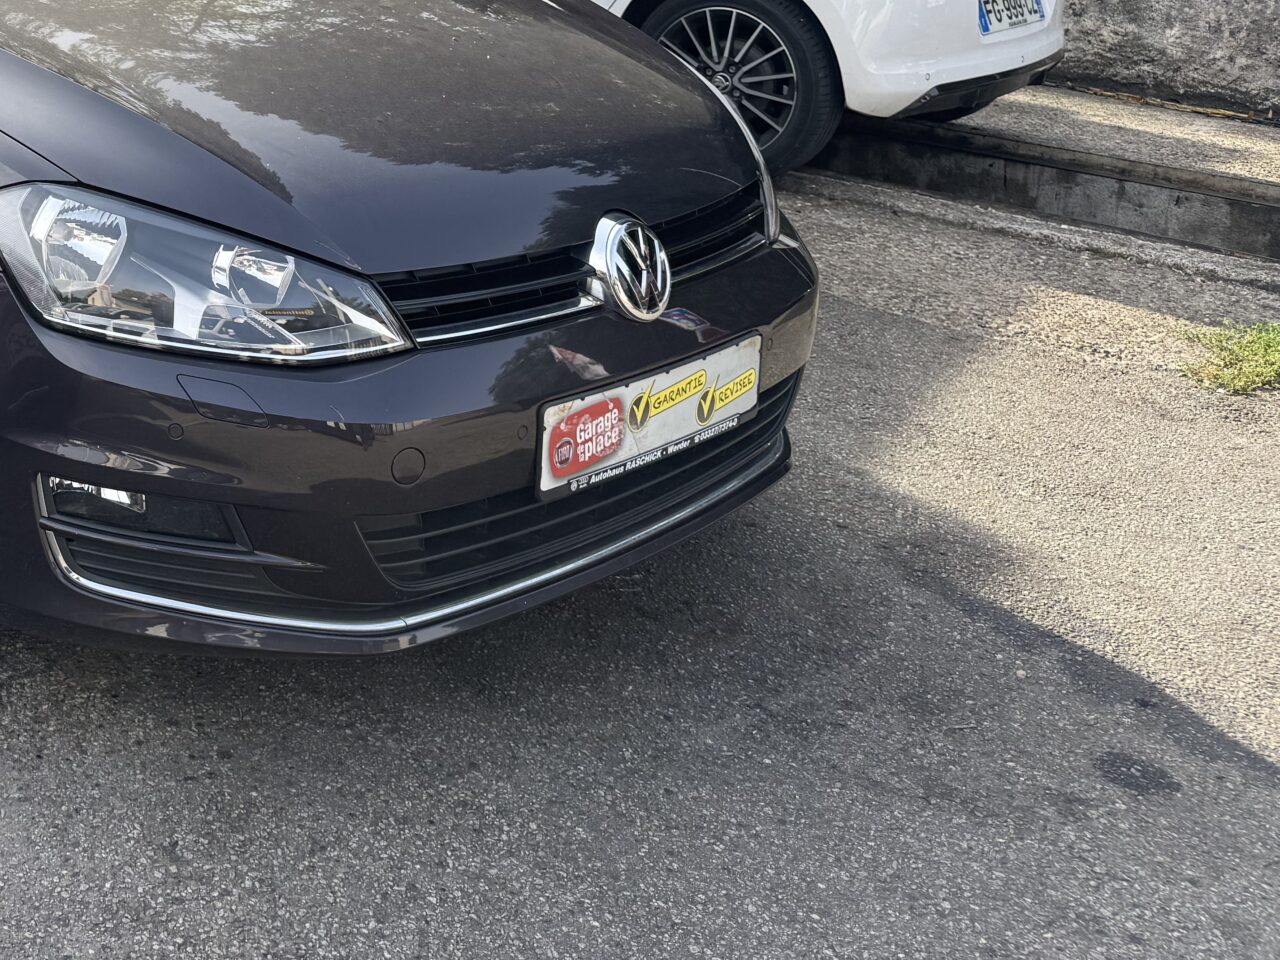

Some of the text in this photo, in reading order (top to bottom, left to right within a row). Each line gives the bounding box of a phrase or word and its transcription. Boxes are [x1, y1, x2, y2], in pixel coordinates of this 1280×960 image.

[653, 373, 704, 410] GARANTIE
[718, 372, 753, 403] REVISEE
[576, 408, 619, 444] Garage
[584, 427, 619, 461] place
[590, 465, 624, 484] Autohaus
[625, 450, 662, 471] RASCHICK
[667, 439, 691, 455] Werder
